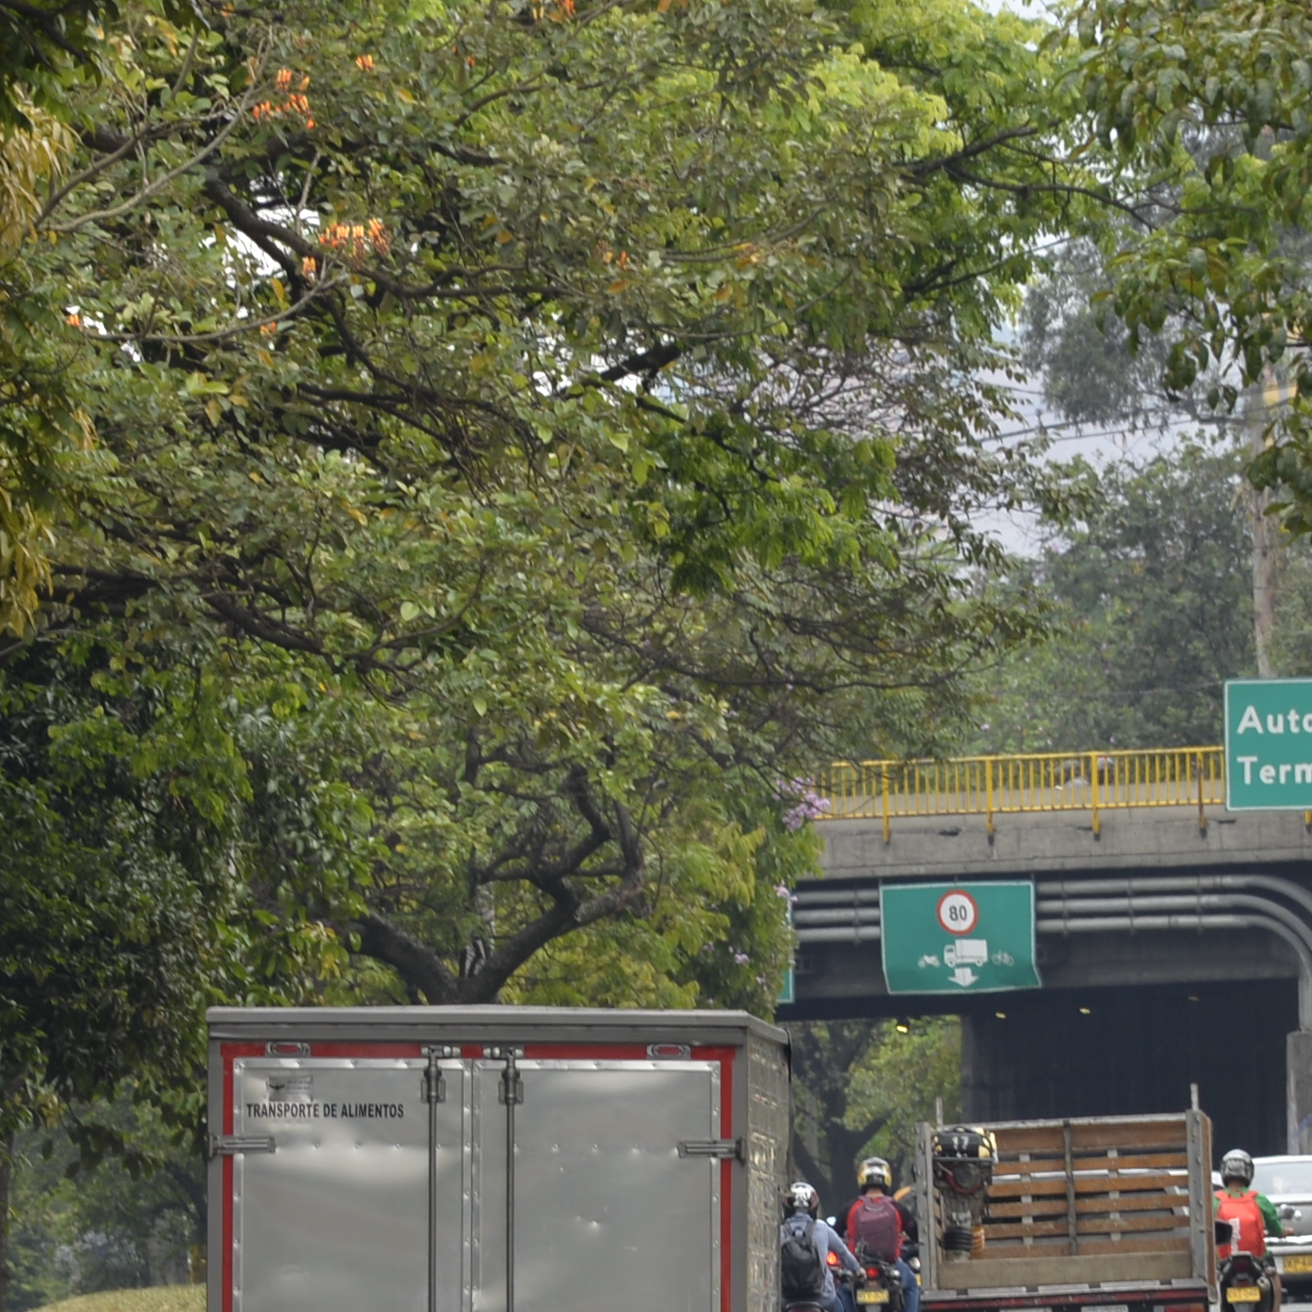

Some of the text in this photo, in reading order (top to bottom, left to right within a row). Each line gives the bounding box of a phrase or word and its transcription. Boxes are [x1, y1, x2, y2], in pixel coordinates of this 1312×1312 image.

[949, 905, 968, 922] 80
[246, 1103, 404, 1119] TRANSPORTE DE ALIMENTOS
